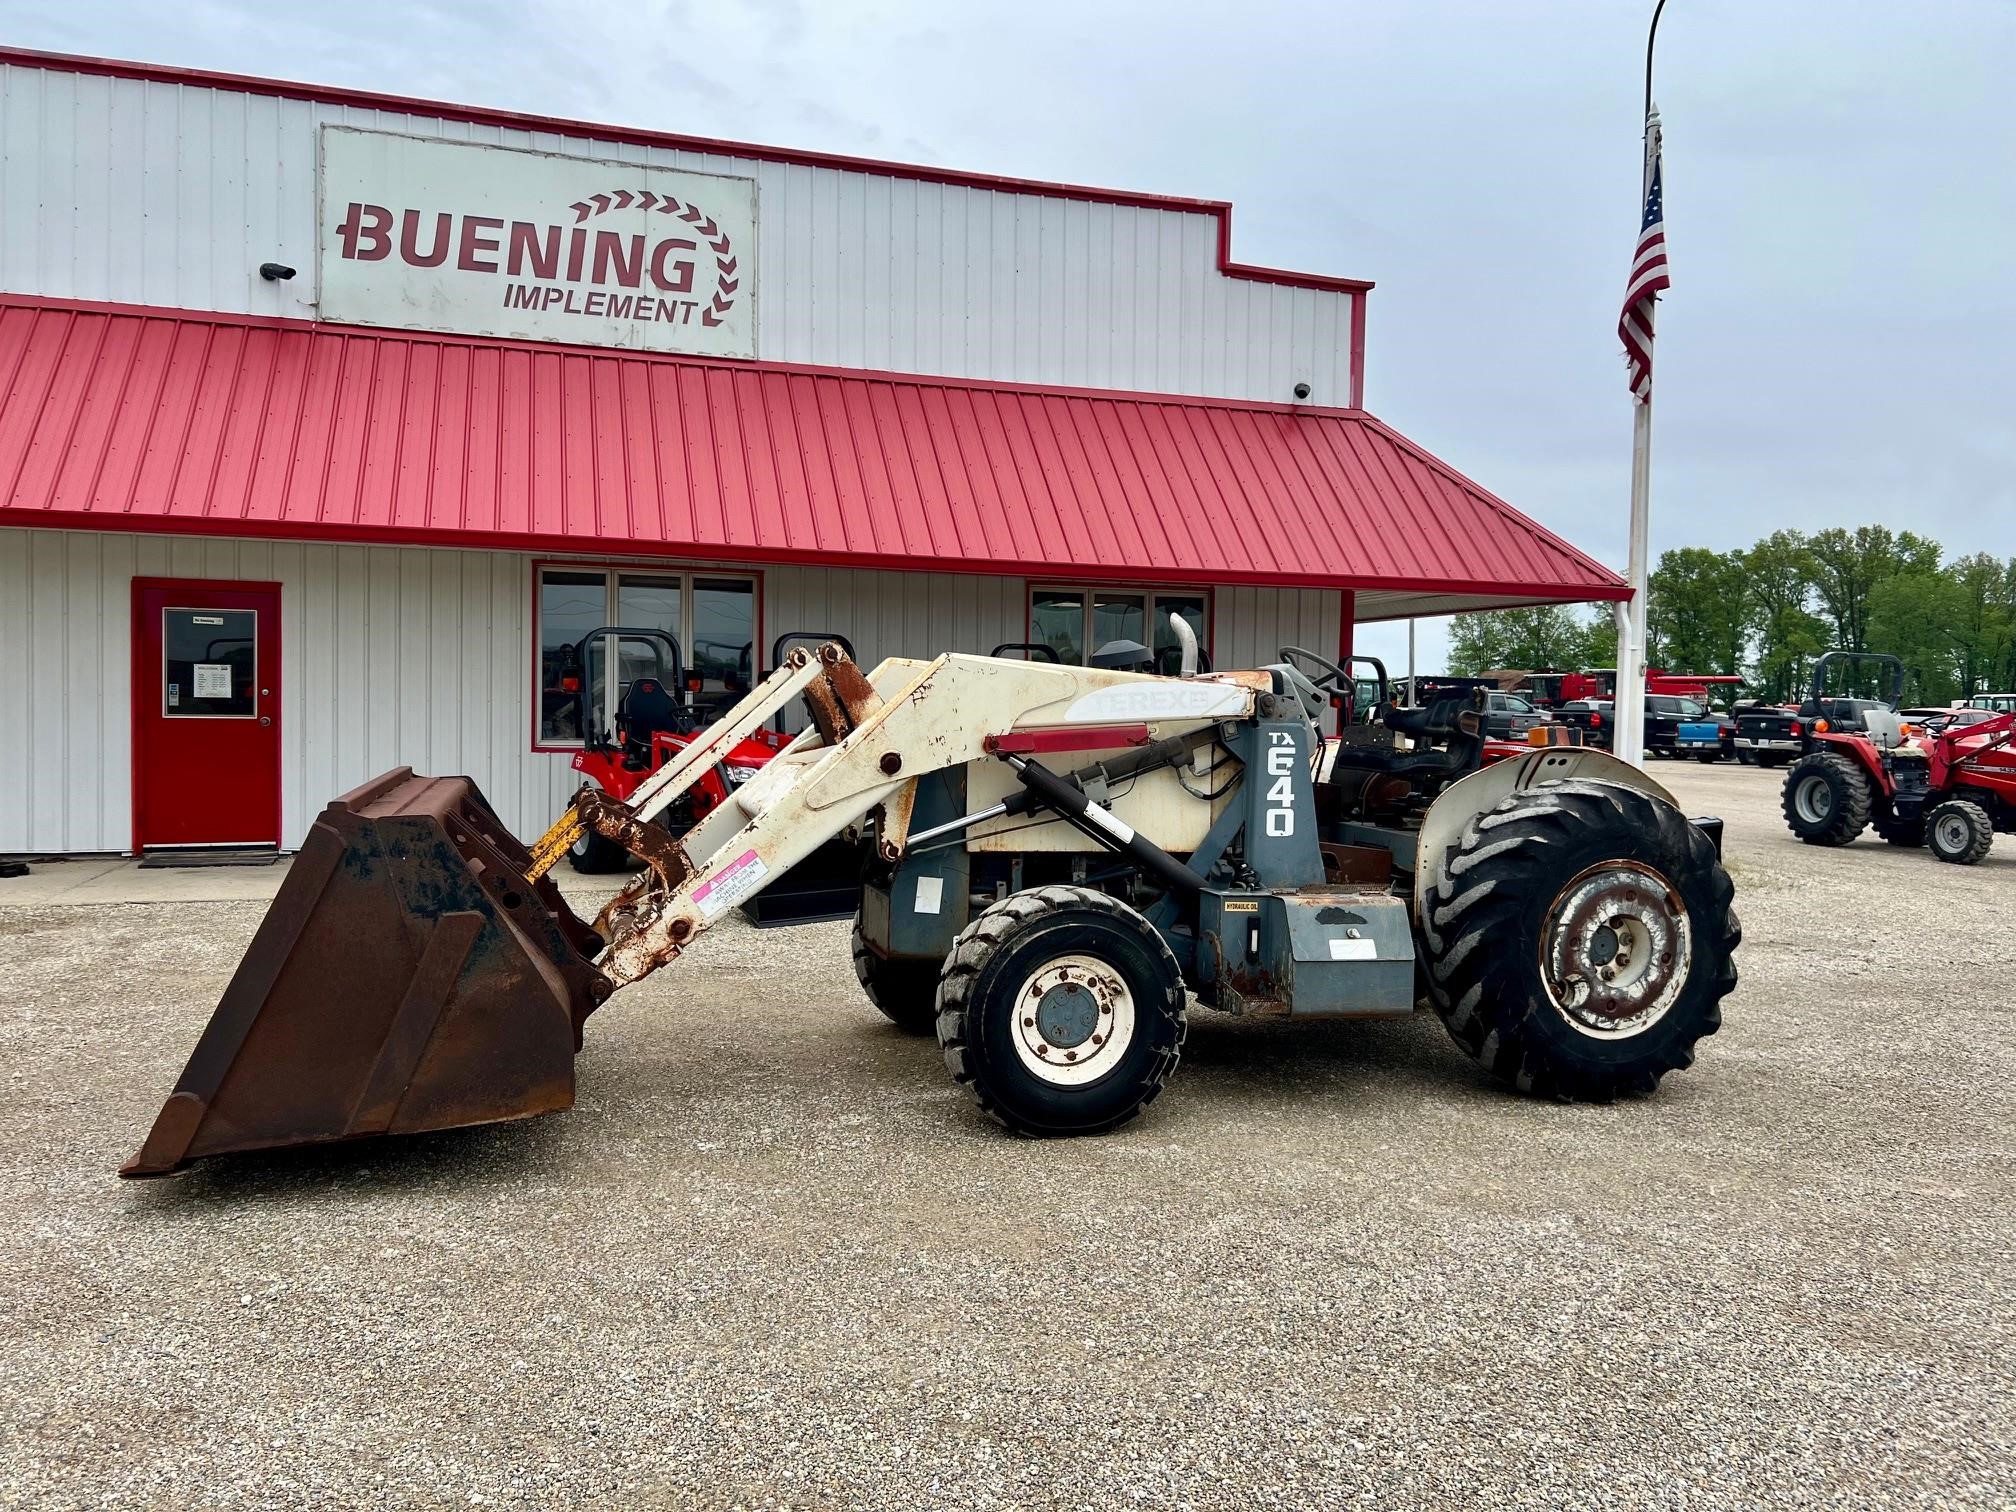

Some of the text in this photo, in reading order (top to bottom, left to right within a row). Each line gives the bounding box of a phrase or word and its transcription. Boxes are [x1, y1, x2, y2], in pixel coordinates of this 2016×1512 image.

[336, 202, 697, 293] BUENING
[503, 284, 698, 325] IMPLEMENT
[1096, 691, 1186, 713] TEREX
[1268, 732, 1296, 745] TX
[1266, 747, 1296, 837] 640
[718, 864, 742, 883] DANGER
[748, 859, 760, 870] THE
[737, 869, 756, 885] WHEN
